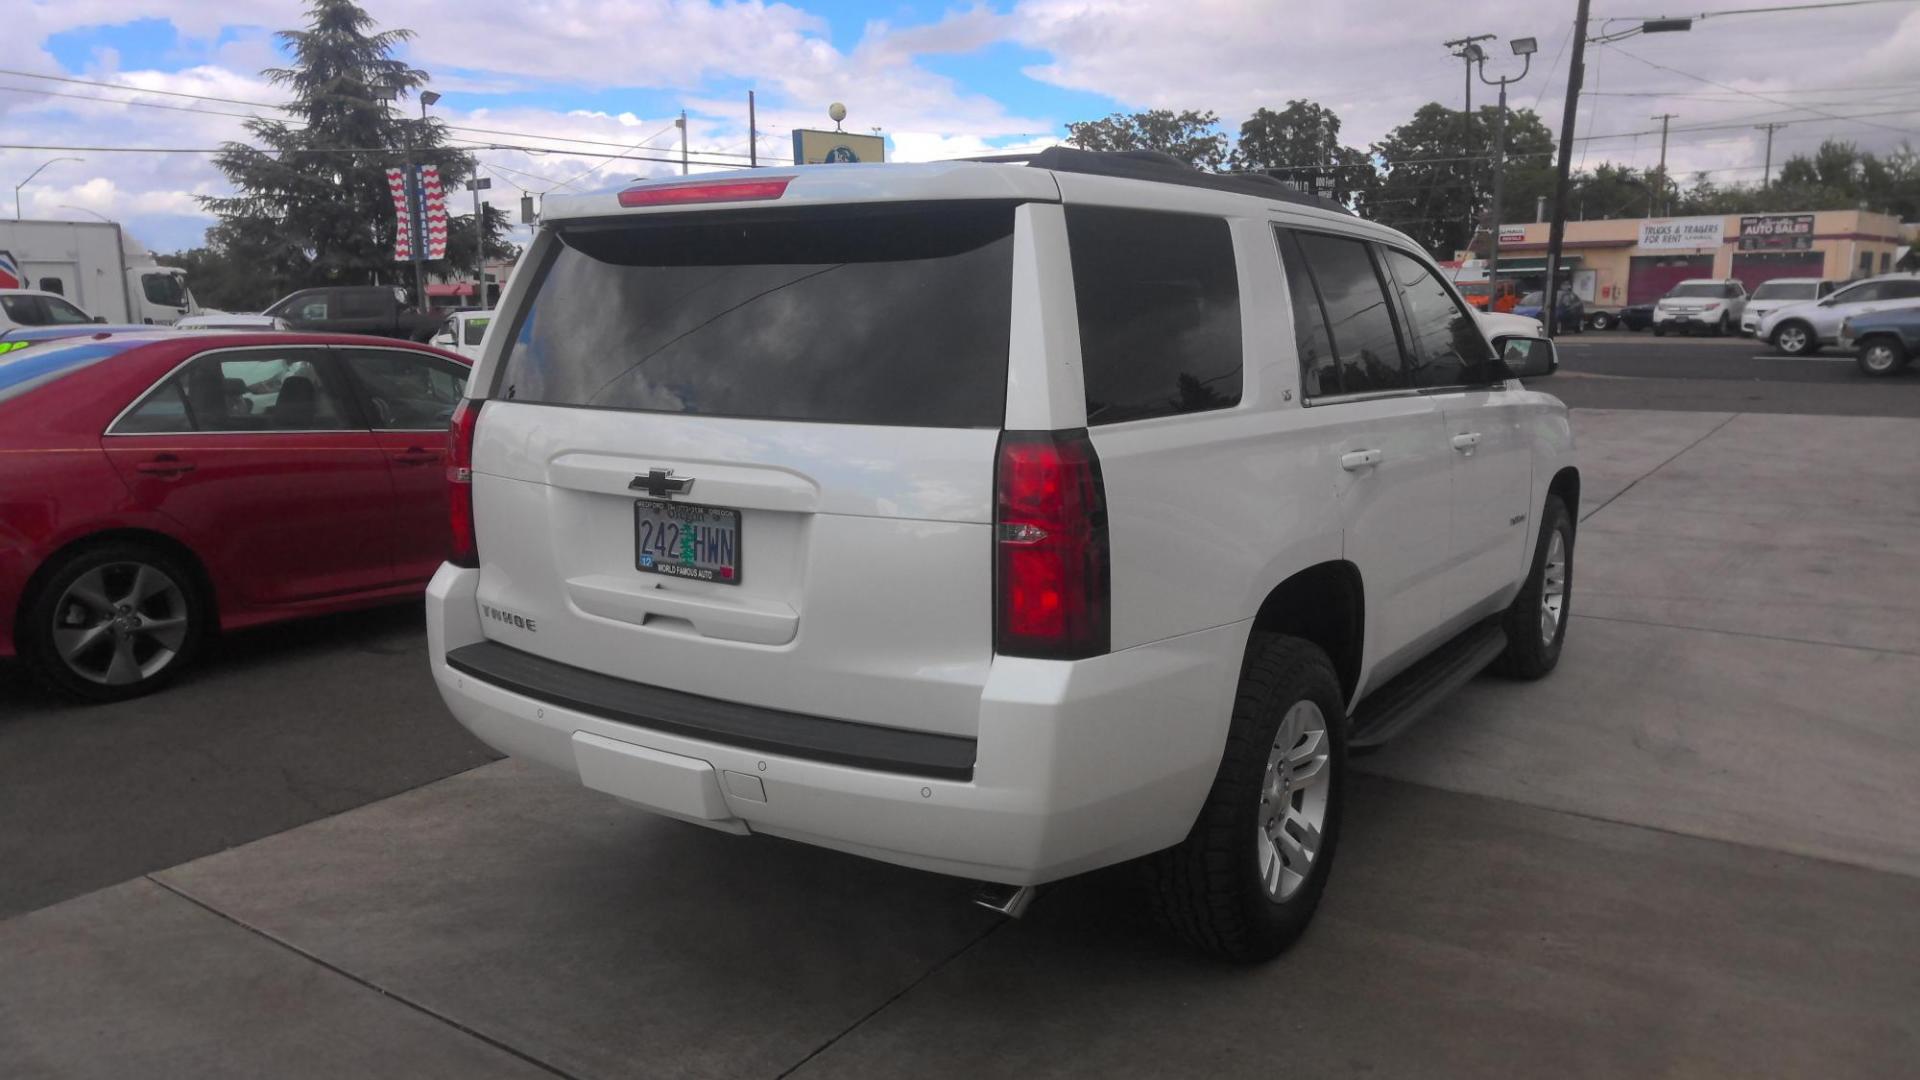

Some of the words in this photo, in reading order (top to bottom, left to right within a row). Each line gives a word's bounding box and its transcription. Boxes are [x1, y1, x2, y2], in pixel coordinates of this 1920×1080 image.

[416, 172, 423, 189] WE
[419, 195, 428, 255] FINANCE
[1645, 225, 1672, 235] TRUCKS
[1745, 223, 1773, 235] AUTO
[1775, 223, 1809, 234] SALES
[1644, 235, 1660, 243] FOR
[1663, 234, 1682, 243] RENT
[641, 520, 679, 559] 242
[693, 525, 734, 565] HWN
[657, 564, 676, 574] WORLD
[676, 566, 698, 577] FAMOUS
[698, 569, 713, 580] AUTO
[482, 604, 537, 632] TAHOE
